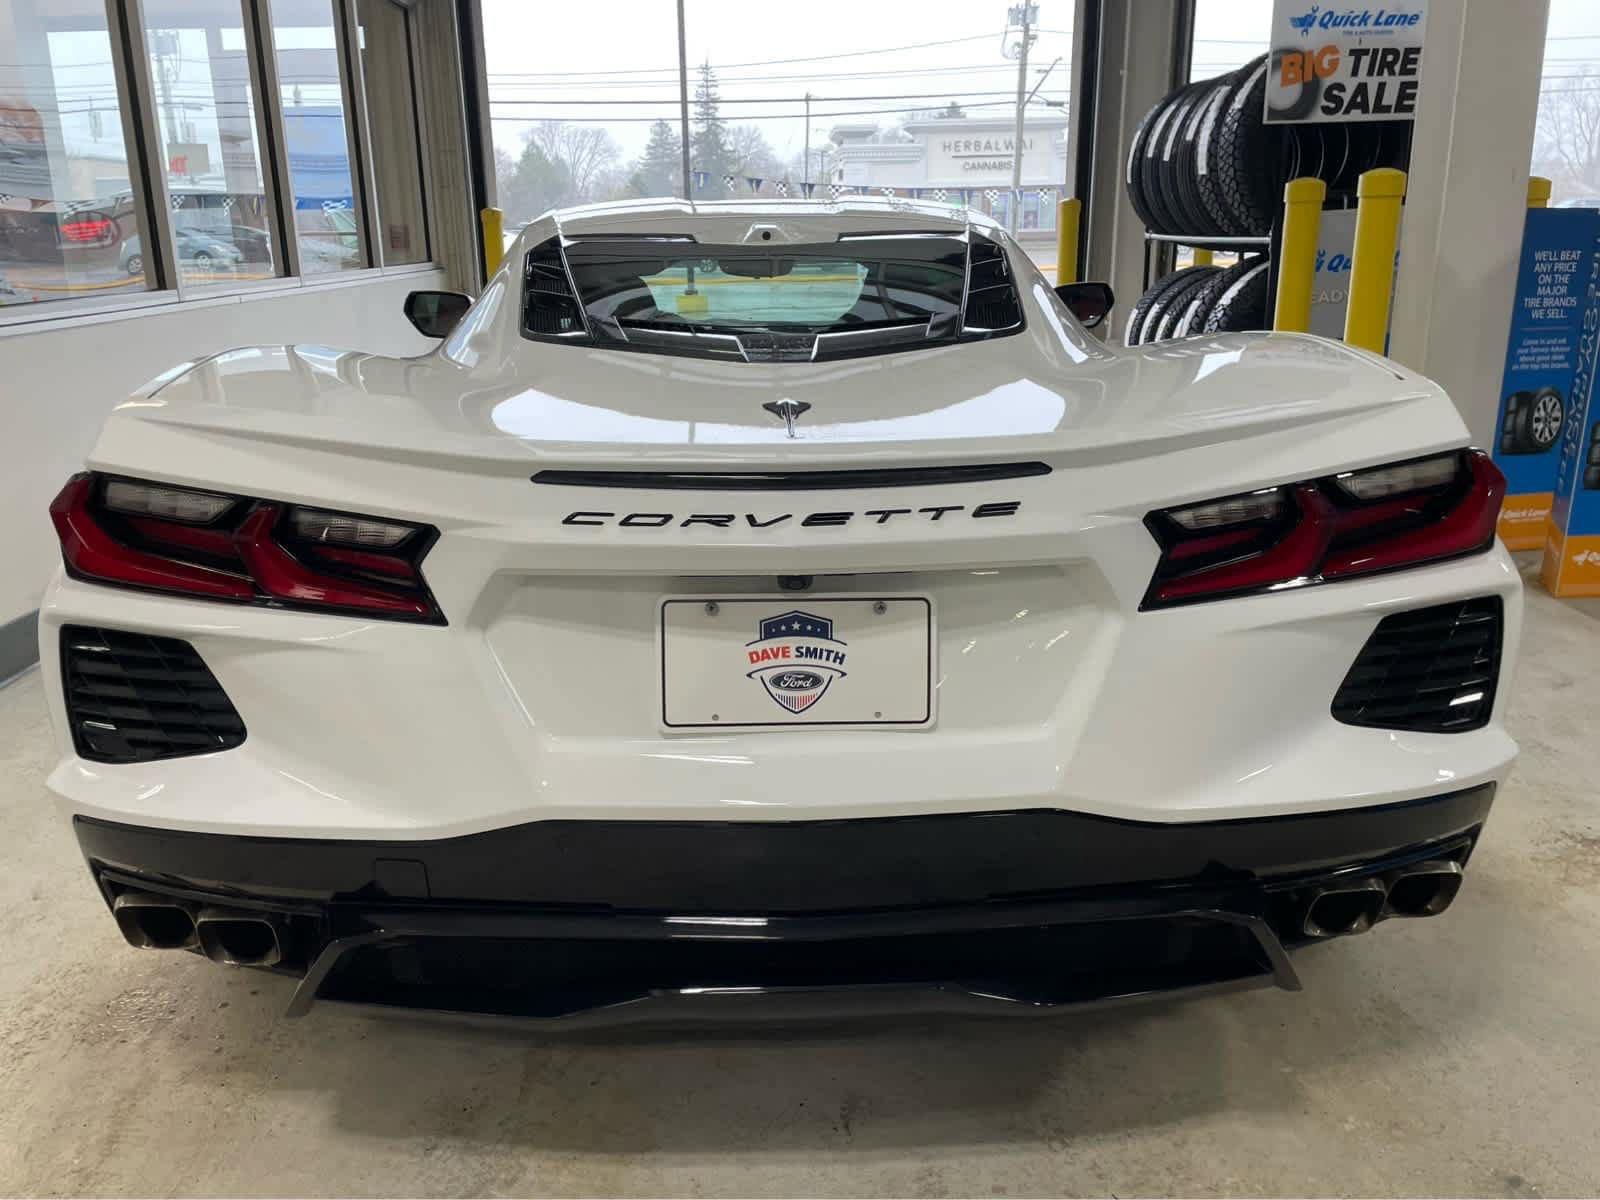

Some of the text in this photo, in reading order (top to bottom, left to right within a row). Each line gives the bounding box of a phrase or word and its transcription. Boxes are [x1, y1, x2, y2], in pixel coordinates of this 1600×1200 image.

[1319, 10, 1420, 29] Quick Lane
[1280, 45, 1422, 88] BIG TIRE
[1321, 81, 1418, 115] SALE
[963, 160, 1014, 171] CANNABIS
[1560, 250, 1582, 260] BEAT
[1534, 262, 1577, 272] ANY PRICE
[1538, 274, 1571, 284] ON THE
[1537, 286, 1568, 296] MAJOR
[1524, 297, 1577, 308] TIRE BRANDS
[1531, 309, 1546, 319] WE
[562, 501, 1021, 527] CORVETTE
[748, 646, 846, 665] DAVE SMITH
[780, 674, 813, 688] Ford
